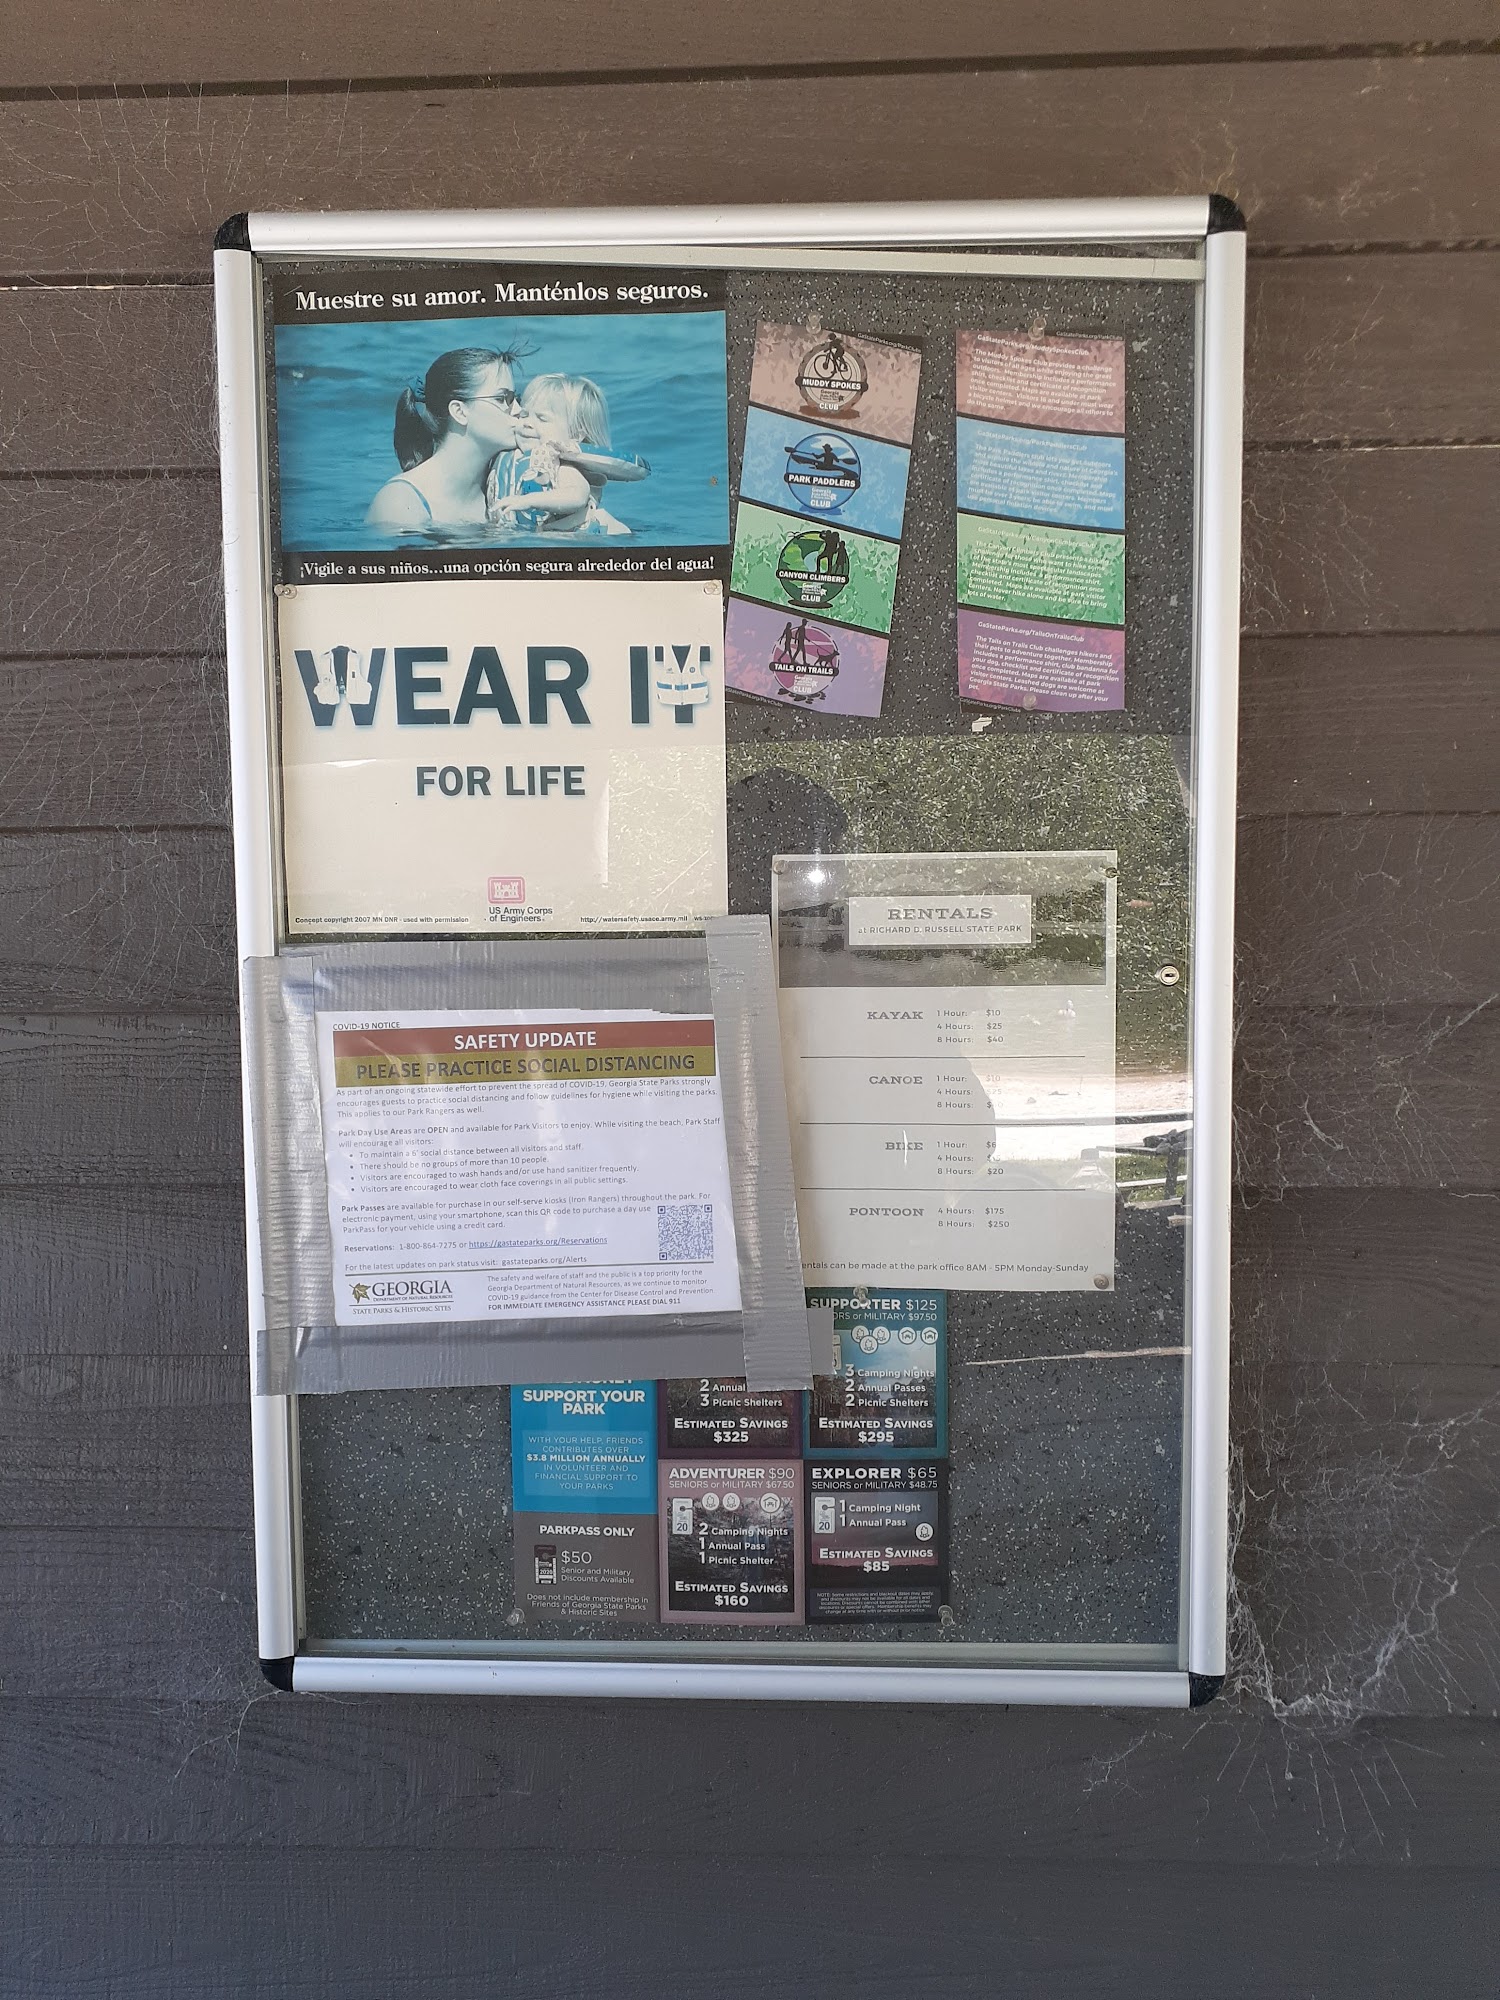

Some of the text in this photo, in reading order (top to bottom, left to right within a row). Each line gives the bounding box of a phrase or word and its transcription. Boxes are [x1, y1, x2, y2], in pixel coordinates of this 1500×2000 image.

[296, 281, 709, 311] Muestre su amor. Manténlos seguros.
[802, 378, 861, 390] MUDDY SPOKES
[819, 402, 839, 411] CLUB
[788, 474, 856, 488] PARK PADDLERS
[810, 500, 831, 508] CLUB
[300, 562, 343, 578] ¡Vigile
[348, 565, 356, 574] a
[361, 564, 385, 575] sus
[474, 559, 521, 575] opción
[526, 561, 573, 574] segura
[578, 558, 646, 572] alrededor
[650, 557, 672, 570] del
[677, 556, 714, 573] agua!
[779, 571, 846, 583] CANYON CLIMBERS
[801, 594, 820, 603] CLUB
[775, 663, 833, 675] TAILS ON TRAILS
[294, 644, 711, 727] WEAR IT
[793, 686, 811, 694] CLUB
[416, 765, 586, 796] FOR LIFE
[504, 907, 525, 915] Army
[527, 907, 552, 915] Corps
[888, 908, 993, 920] RENTALS
[295, 917, 322, 925] Concept
[867, 1011, 923, 1020] KAYAK
[986, 1009, 1000, 1017] $10
[333, 1021, 400, 1031] COVID-19 NOTICE
[454, 1031, 596, 1050] SAFETY UPDATE
[987, 1035, 1003, 1043] $40
[357, 1054, 695, 1079] PLEASE PRACTICE SOCIAL DISTANCING
[869, 1076, 923, 1085] CANOE
[885, 1142, 923, 1150] BIKE
[987, 1167, 1004, 1175] $20
[849, 1207, 924, 1216] PONTOON
[985, 1207, 1004, 1215] $175
[947, 1220, 974, 1228] Hours:
[988, 1220, 1010, 1228] $250
[344, 1244, 395, 1252] Reservations:
[399, 1242, 457, 1250] 1-800-864-7275
[468, 1237, 607, 1249] https://gastateparks.org/Reservations
[862, 1262, 887, 1270] made
[918, 1263, 938, 1271] park
[1017, 1264, 1088, 1273] Monday-Sunday
[372, 1280, 452, 1296] GEORGIA
[503, 1302, 542, 1310] IMMEDIATE
[586, 1298, 626, 1307] ASSISTANCE
[627, 1298, 650, 1306] PLEASE
[652, 1297, 668, 1306] DIAL
[669, 1297, 680, 1305] 911
[906, 1299, 937, 1311] $125
[845, 1364, 935, 1378] 3 Camping Nights
[845, 1379, 926, 1392] 2 Annual Passes
[523, 1390, 645, 1403] SUPPORT YOUR
[845, 1394, 928, 1407] 2 Picnic Shelters
[563, 1403, 605, 1415] PARK
[674, 1417, 788, 1429] ESTIMATED SAVINGS
[819, 1418, 933, 1429] ESTIMATED SAVINGS
[713, 1431, 749, 1443] $325
[858, 1431, 894, 1443] $295
[526, 1454, 645, 1463] $3.8 MILLION ANNUALLY
[669, 1467, 794, 1480] ADVENTURER $90
[812, 1467, 937, 1480] EXPLORER $65
[812, 1481, 851, 1489] SENIORS
[866, 1481, 907, 1489] MILITARY
[909, 1480, 938, 1489] $48.75
[840, 1500, 921, 1514] 1 Camping Night
[840, 1514, 846, 1526] 1
[849, 1519, 882, 1527] Annual
[539, 1525, 635, 1537] PARKPASS ONLY
[561, 1550, 592, 1565] $50
[820, 1547, 933, 1559] ESTIMATED SAVINGS
[863, 1560, 890, 1573] $85
[675, 1581, 788, 1593] ESTIMATED SAVINGS
[715, 1594, 749, 1606] $160
